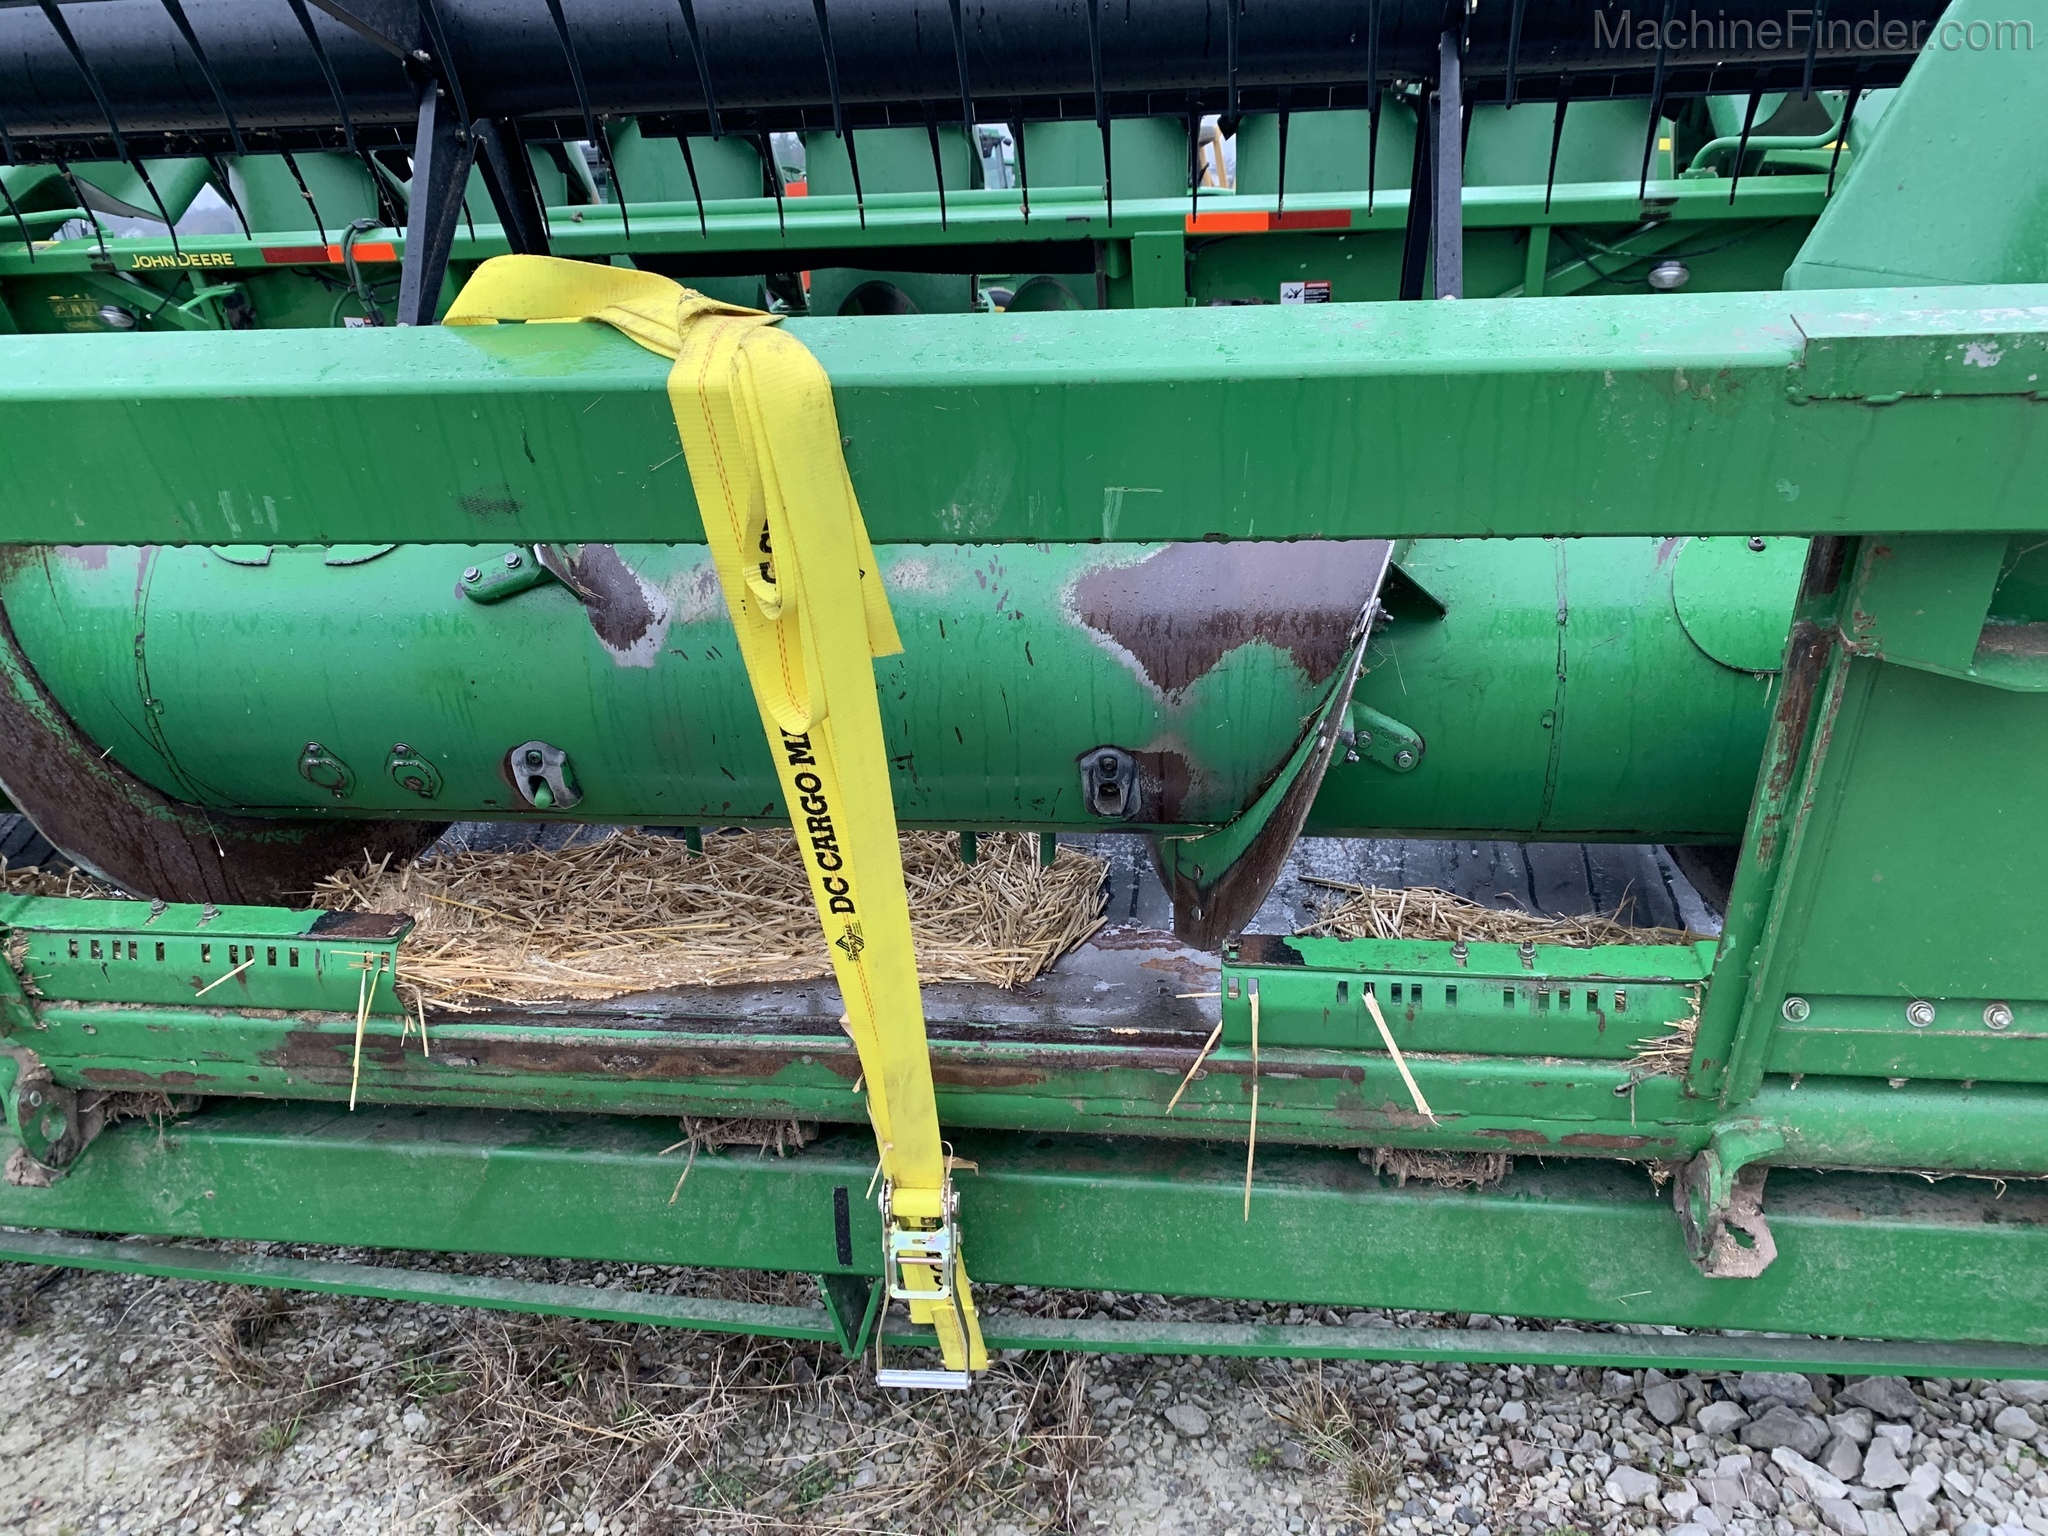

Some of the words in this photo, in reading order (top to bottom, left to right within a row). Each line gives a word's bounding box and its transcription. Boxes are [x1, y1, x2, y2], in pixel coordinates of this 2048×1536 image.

[131, 253, 177, 269] JOHN
[178, 252, 235, 267] DEERE
[794, 772, 843, 872] CARGO
[822, 876, 856, 915] DC
